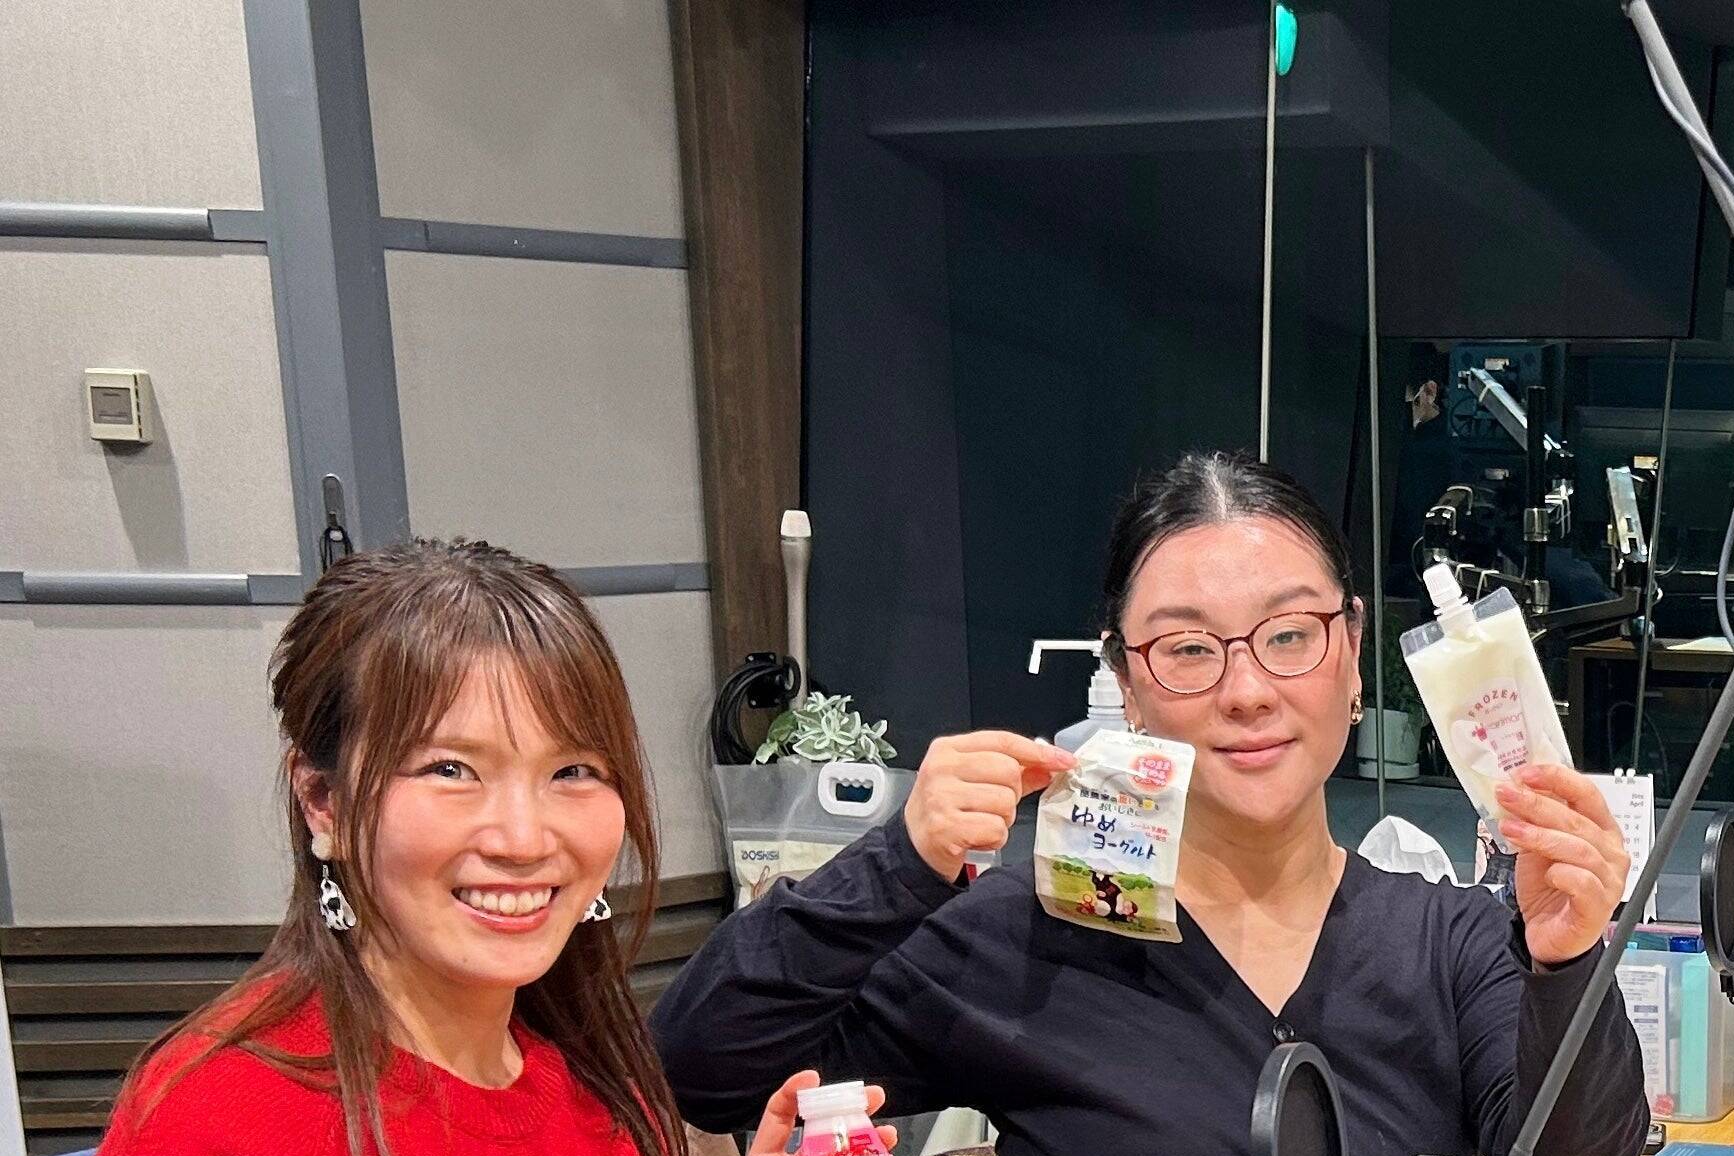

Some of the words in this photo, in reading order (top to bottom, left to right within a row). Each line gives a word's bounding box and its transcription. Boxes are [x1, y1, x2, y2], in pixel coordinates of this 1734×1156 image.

[1468, 689, 1519, 718] FROZEN
[1071, 804, 1118, 833] ゆめ
[1093, 832, 1157, 860] ヨーグルト
